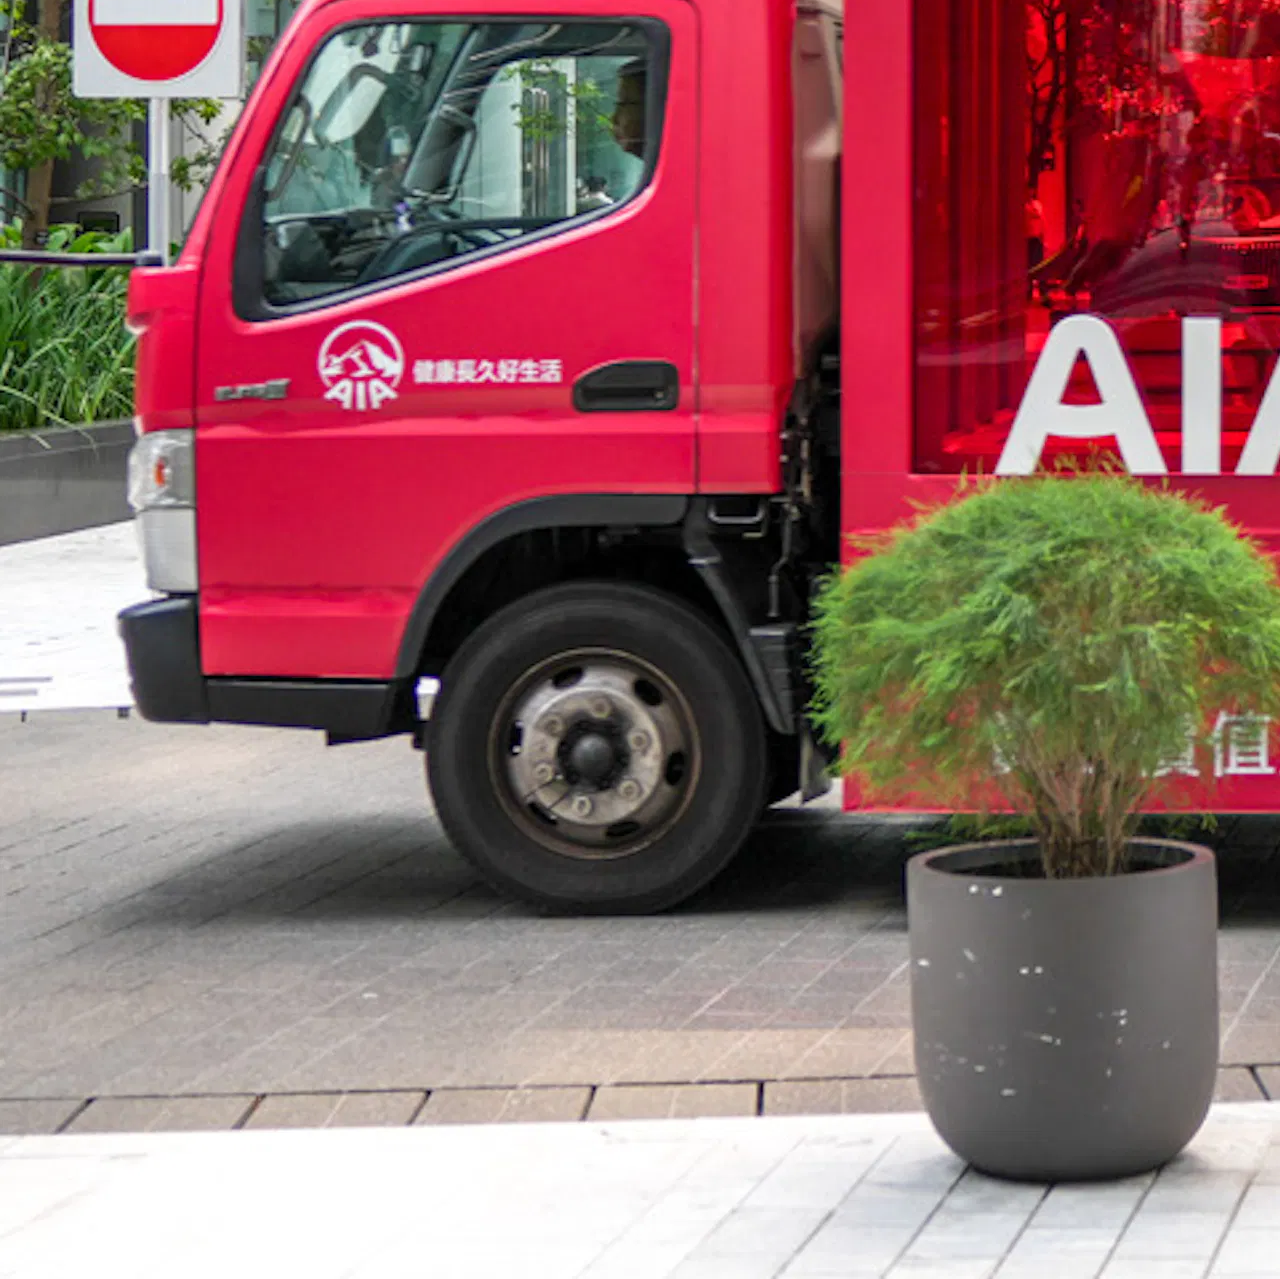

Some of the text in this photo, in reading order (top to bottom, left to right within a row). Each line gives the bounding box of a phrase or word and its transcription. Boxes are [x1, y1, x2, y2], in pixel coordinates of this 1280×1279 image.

[413, 359, 563, 383] 健康長久好生活
[325, 379, 398, 410] AIA
